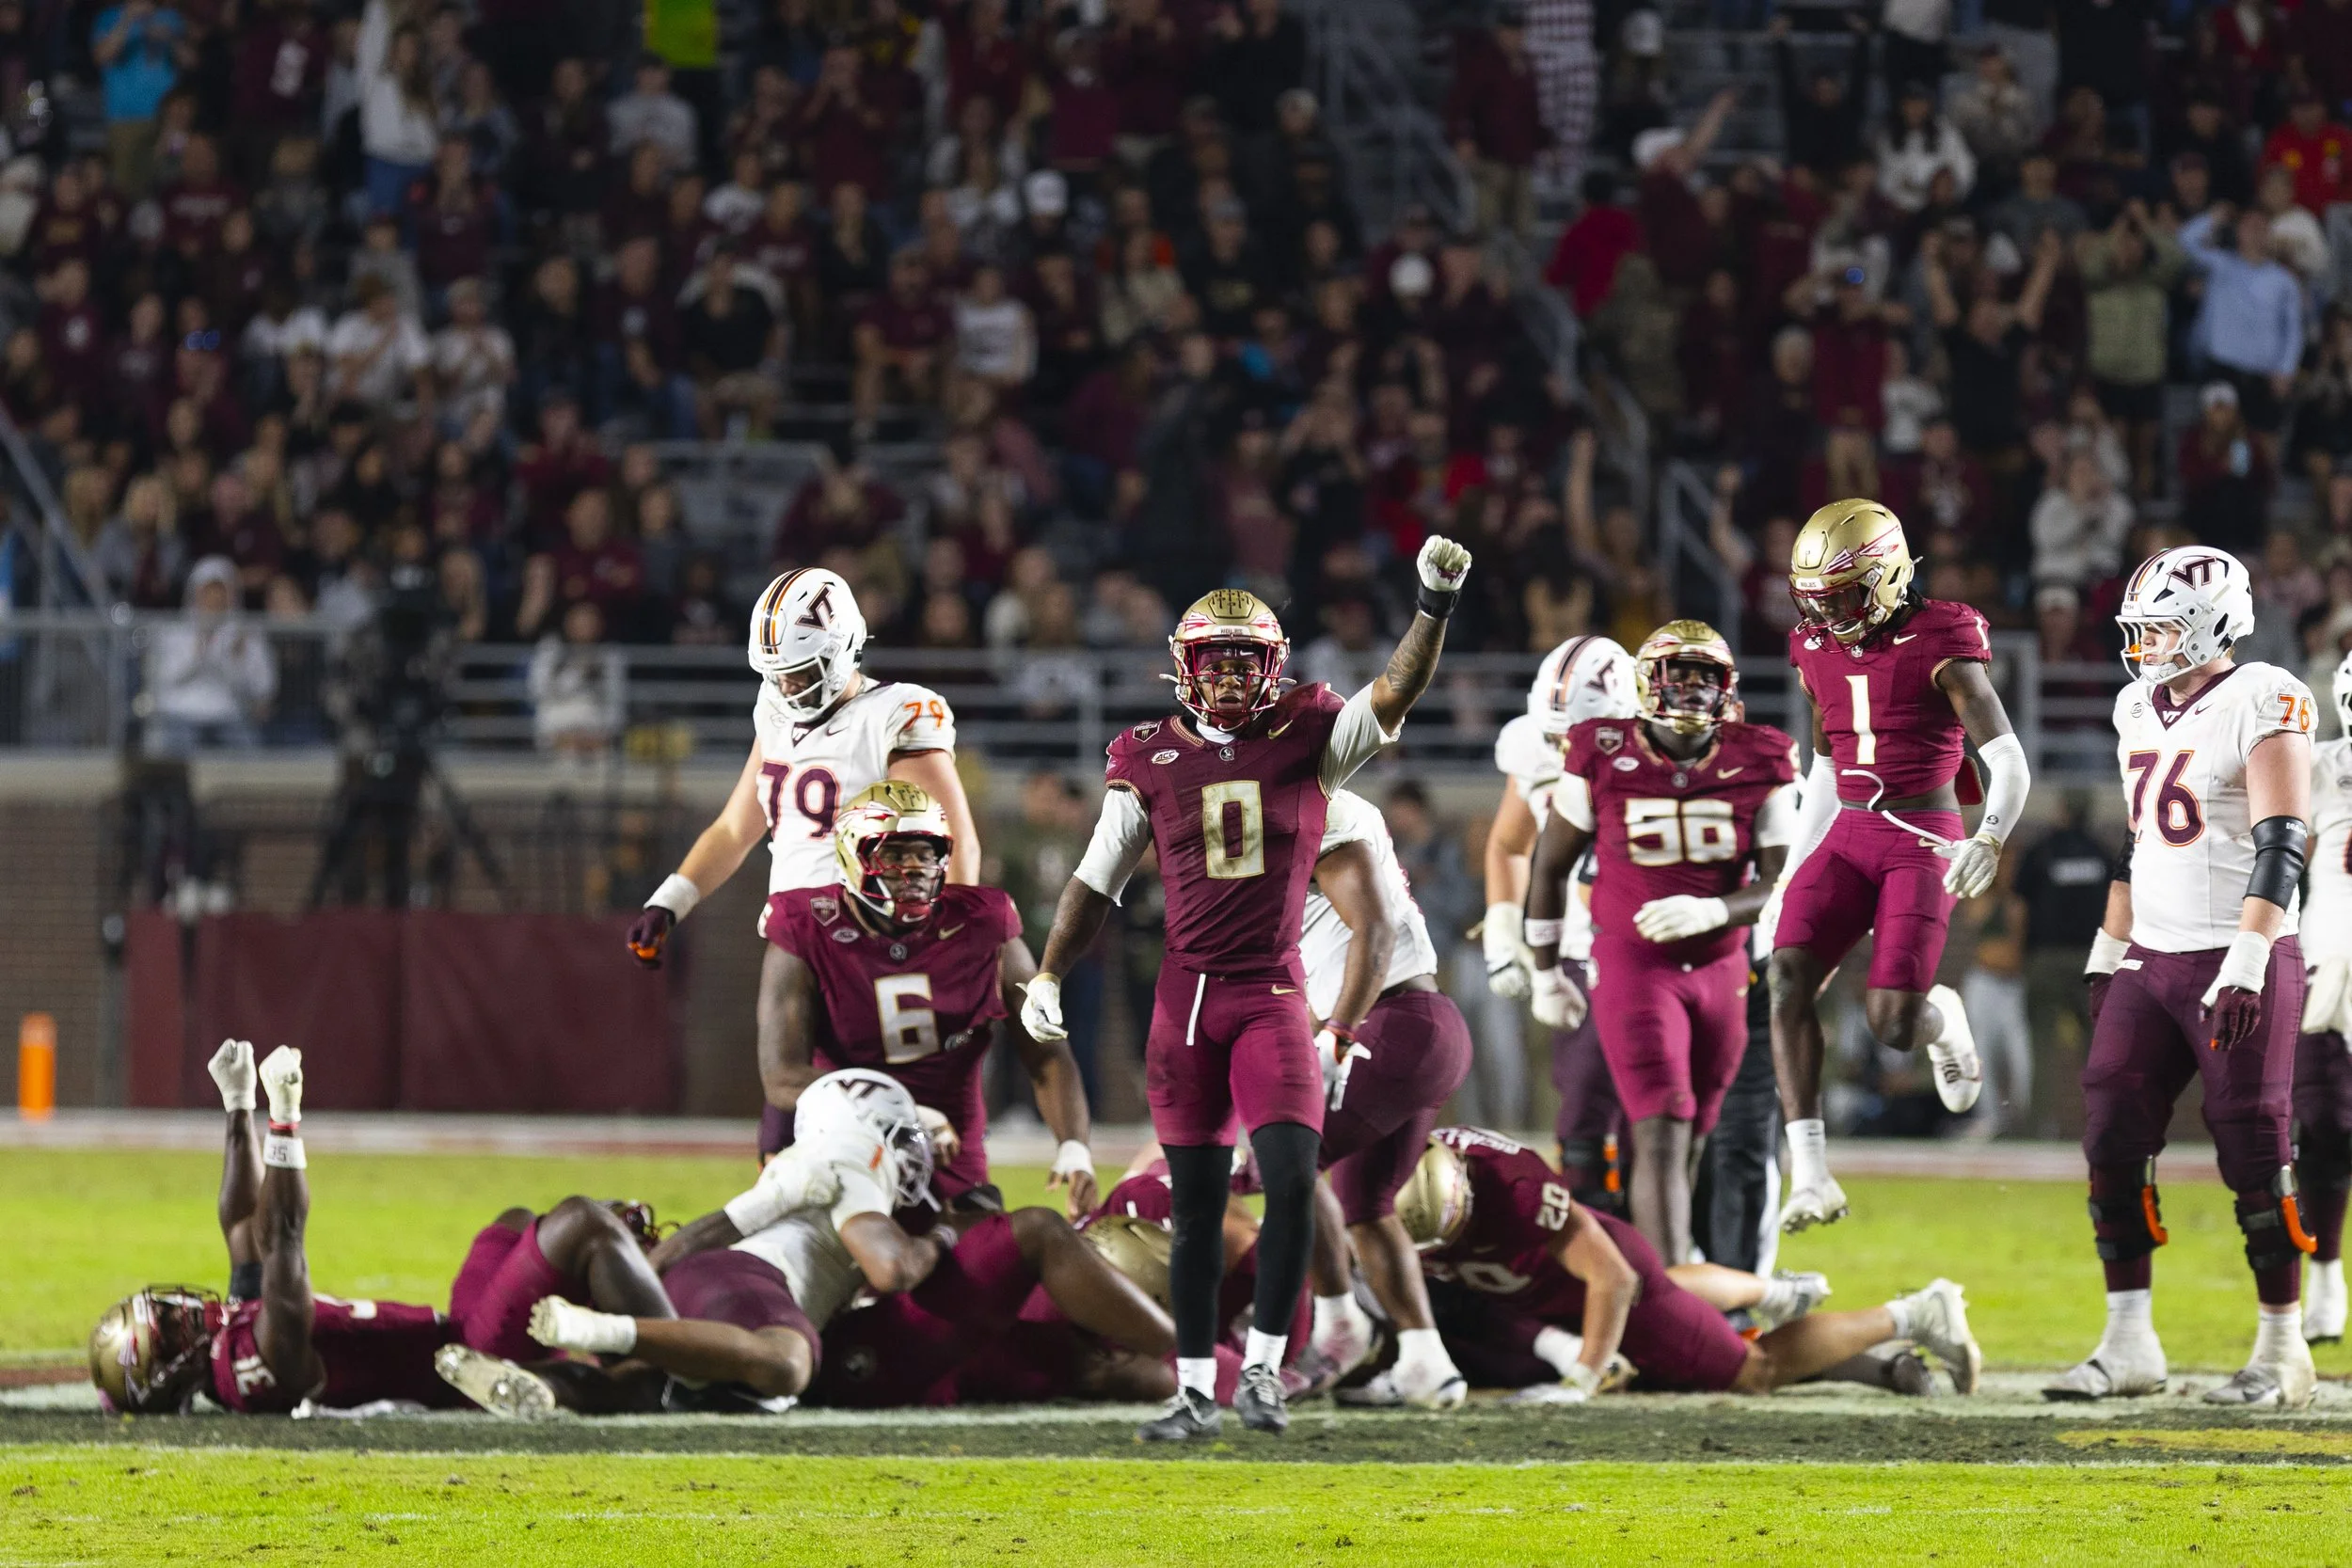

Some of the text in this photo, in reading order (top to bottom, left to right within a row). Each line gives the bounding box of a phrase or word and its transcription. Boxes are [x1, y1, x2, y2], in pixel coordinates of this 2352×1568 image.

[2167, 556, 2218, 591] VT
[795, 583, 836, 631] VT
[1976, 616, 1989, 651] 1
[901, 700, 945, 731] 79
[1844, 674, 1877, 765] 1
[2162, 710, 2182, 723] VT
[2278, 693, 2312, 733] 76
[757, 761, 840, 839] 79
[2126, 750, 2206, 847] 76
[1201, 780, 1265, 879] 0
[1624, 798, 1738, 866] 56
[873, 974, 940, 1065] 6
[835, 1077, 892, 1099] VT
[1535, 1181, 1570, 1231] 20
